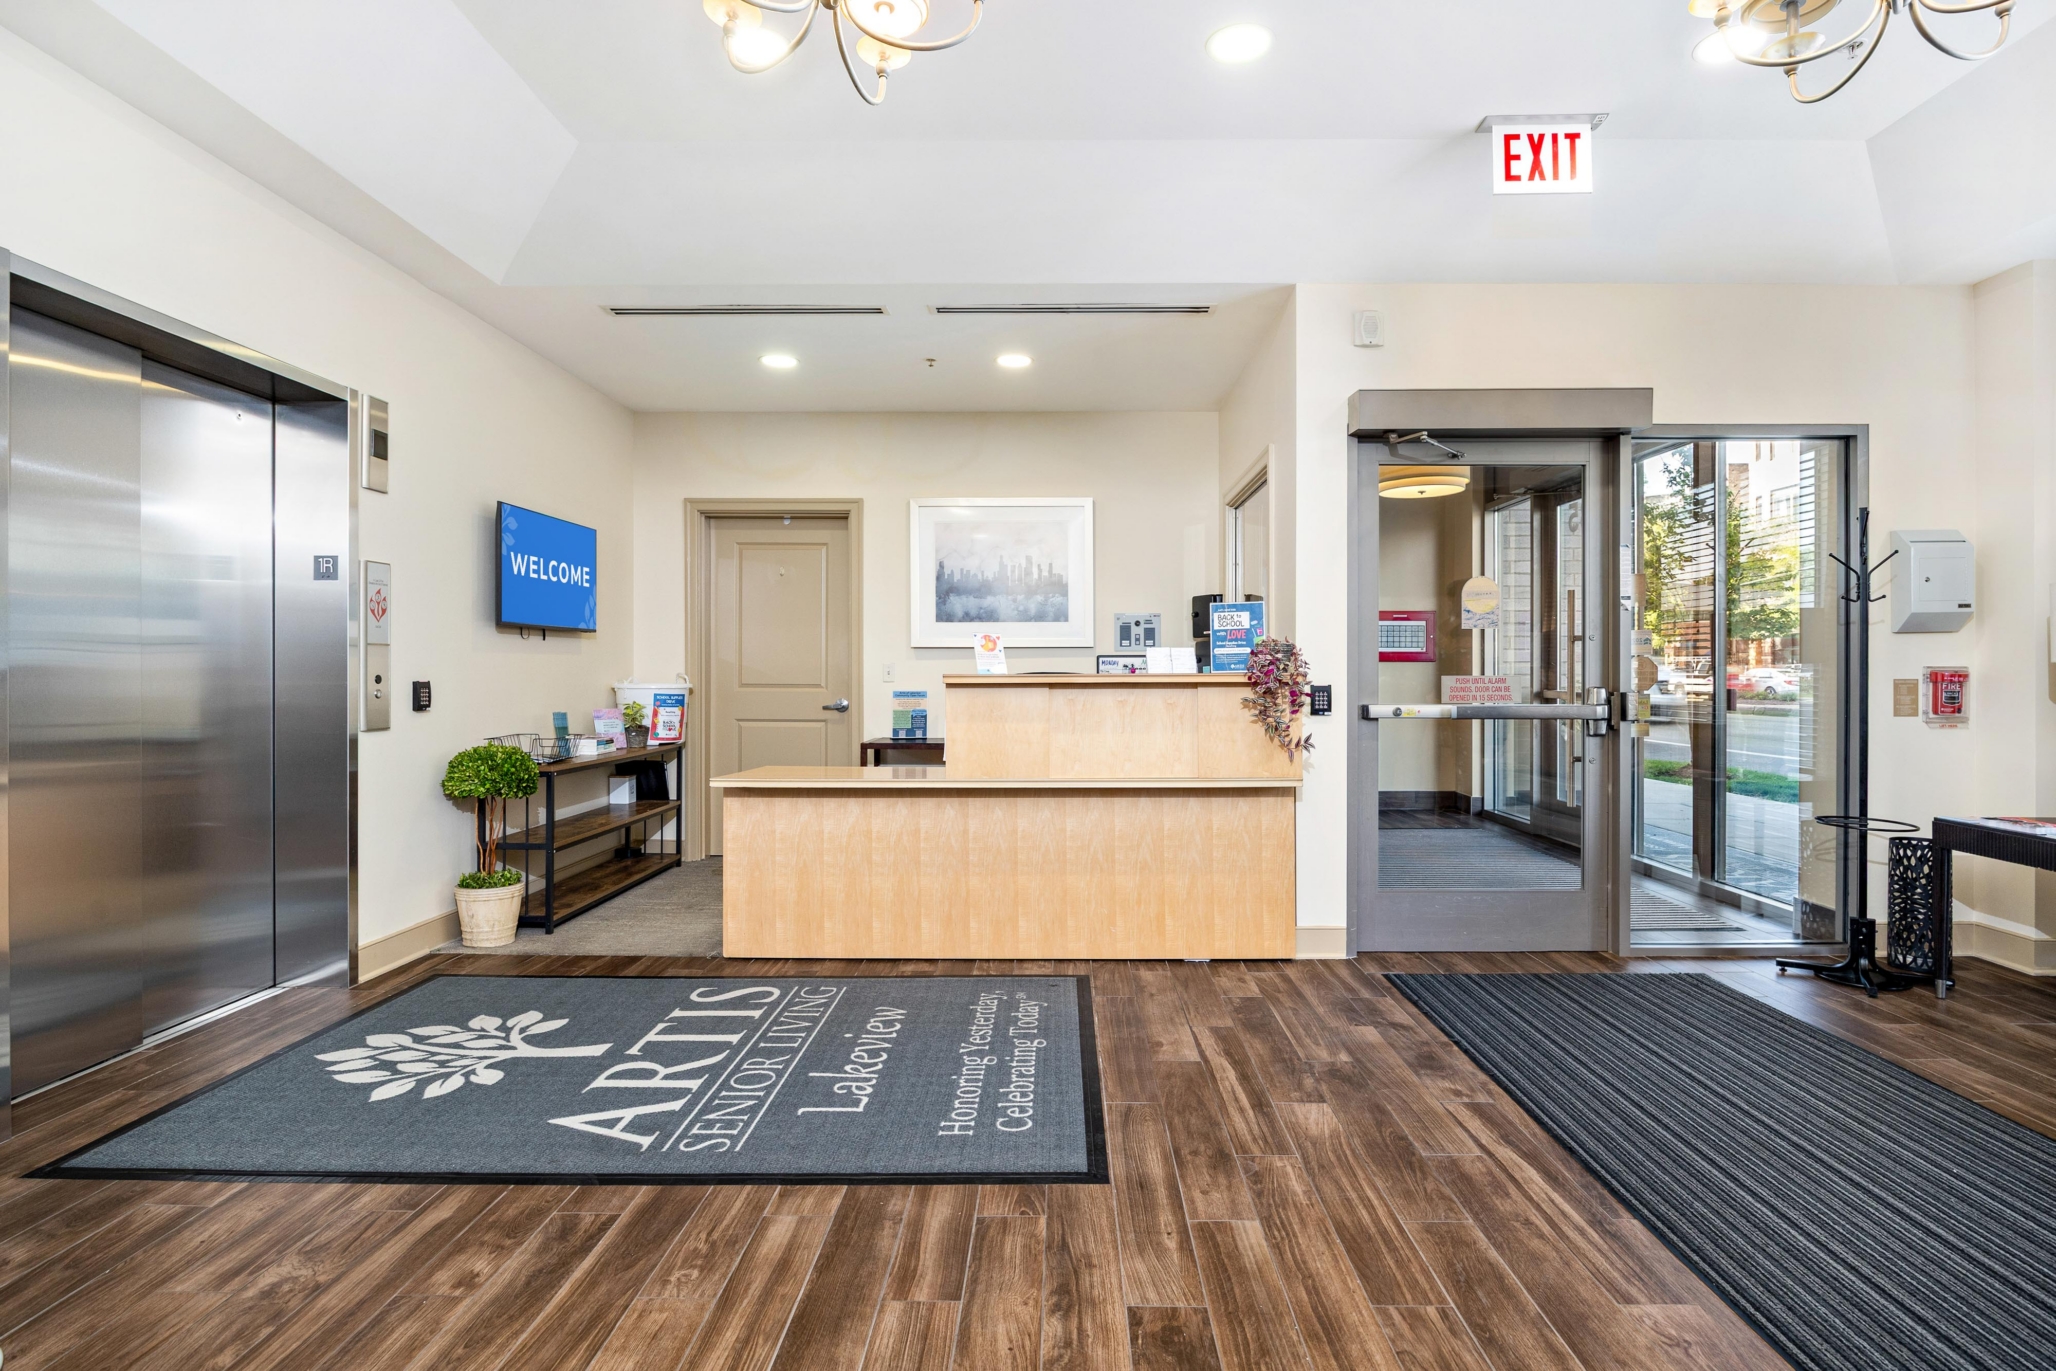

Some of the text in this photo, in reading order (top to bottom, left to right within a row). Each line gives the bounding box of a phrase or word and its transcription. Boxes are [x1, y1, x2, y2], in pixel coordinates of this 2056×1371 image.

[1503, 132, 1581, 181] EXIT
[317, 557, 333, 573] 1R
[510, 551, 590, 588] WELCOME
[1217, 613, 1235, 621] BACK
[1217, 620, 1245, 628] SCHOOL
[1227, 629, 1247, 639] LOVE
[1101, 659, 1119, 667] MONDAY
[1448, 694, 1471, 702] OPENED
[1942, 682, 1961, 690] FIRE
[547, 986, 781, 1152] ARTIS
[679, 986, 837, 1152] SENIOR LIVING
[797, 1006, 908, 1116] Lakeview
[938, 990, 1008, 1136] Honoring Yesterday,
[996, 1038, 1047, 1132] Celebrating
